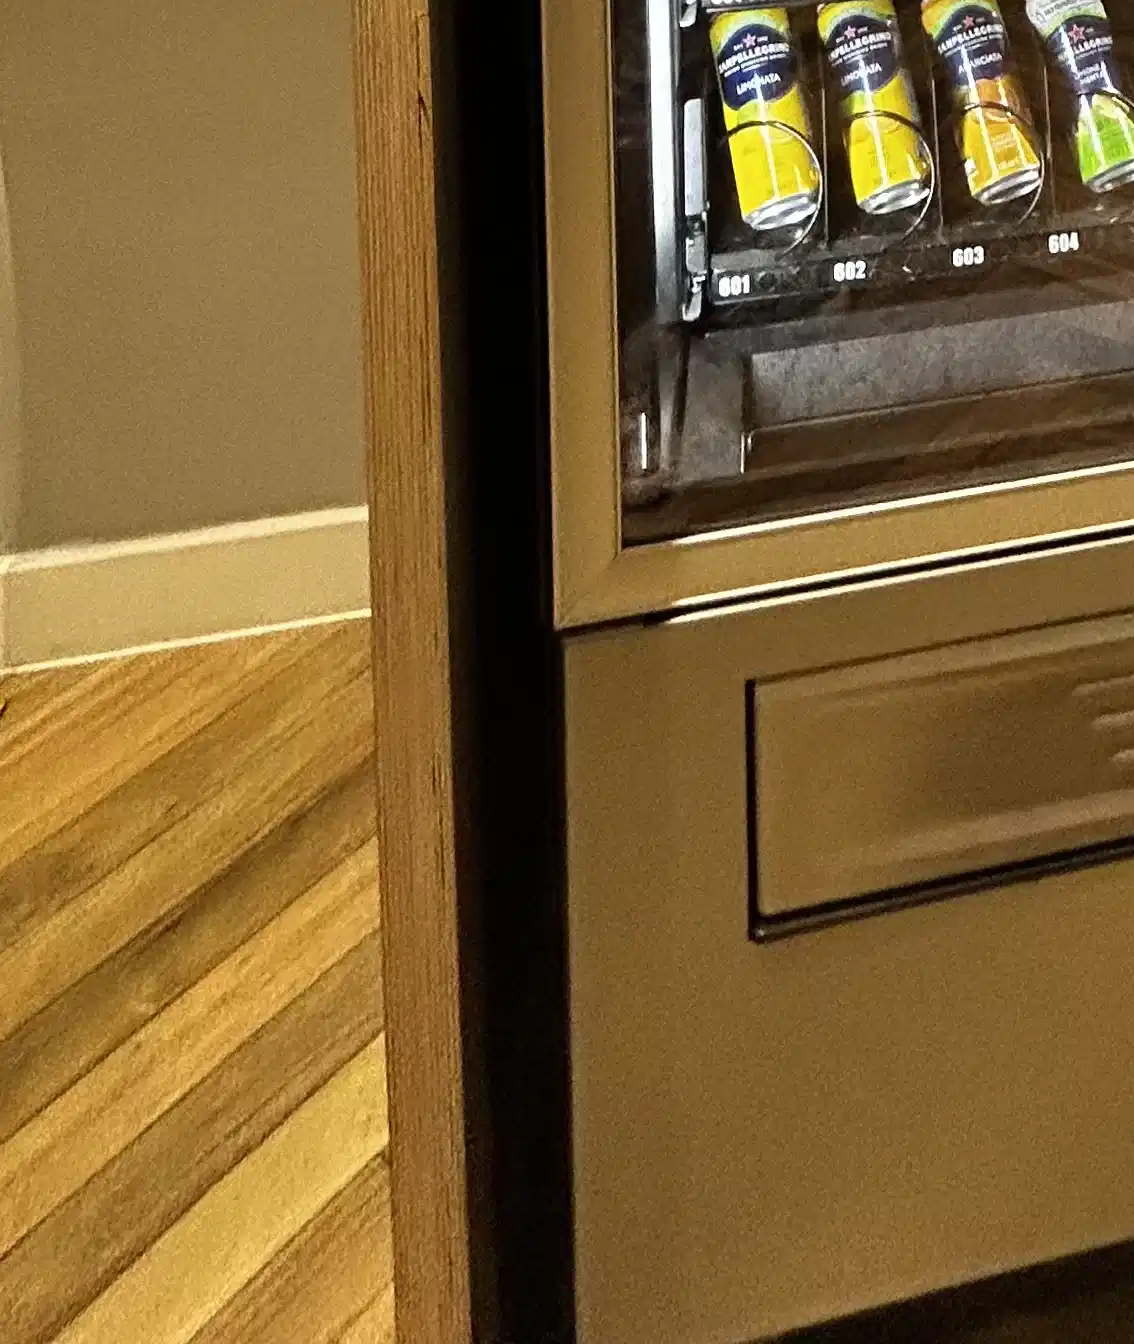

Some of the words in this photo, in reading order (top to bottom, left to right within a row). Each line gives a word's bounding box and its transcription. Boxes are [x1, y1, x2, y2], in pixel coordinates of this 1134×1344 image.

[841, 62, 883, 87] LIMOATA
[1048, 231, 1080, 254] 604
[952, 245, 985, 267] 603
[834, 261, 867, 282] 602
[718, 274, 751, 297] 601
